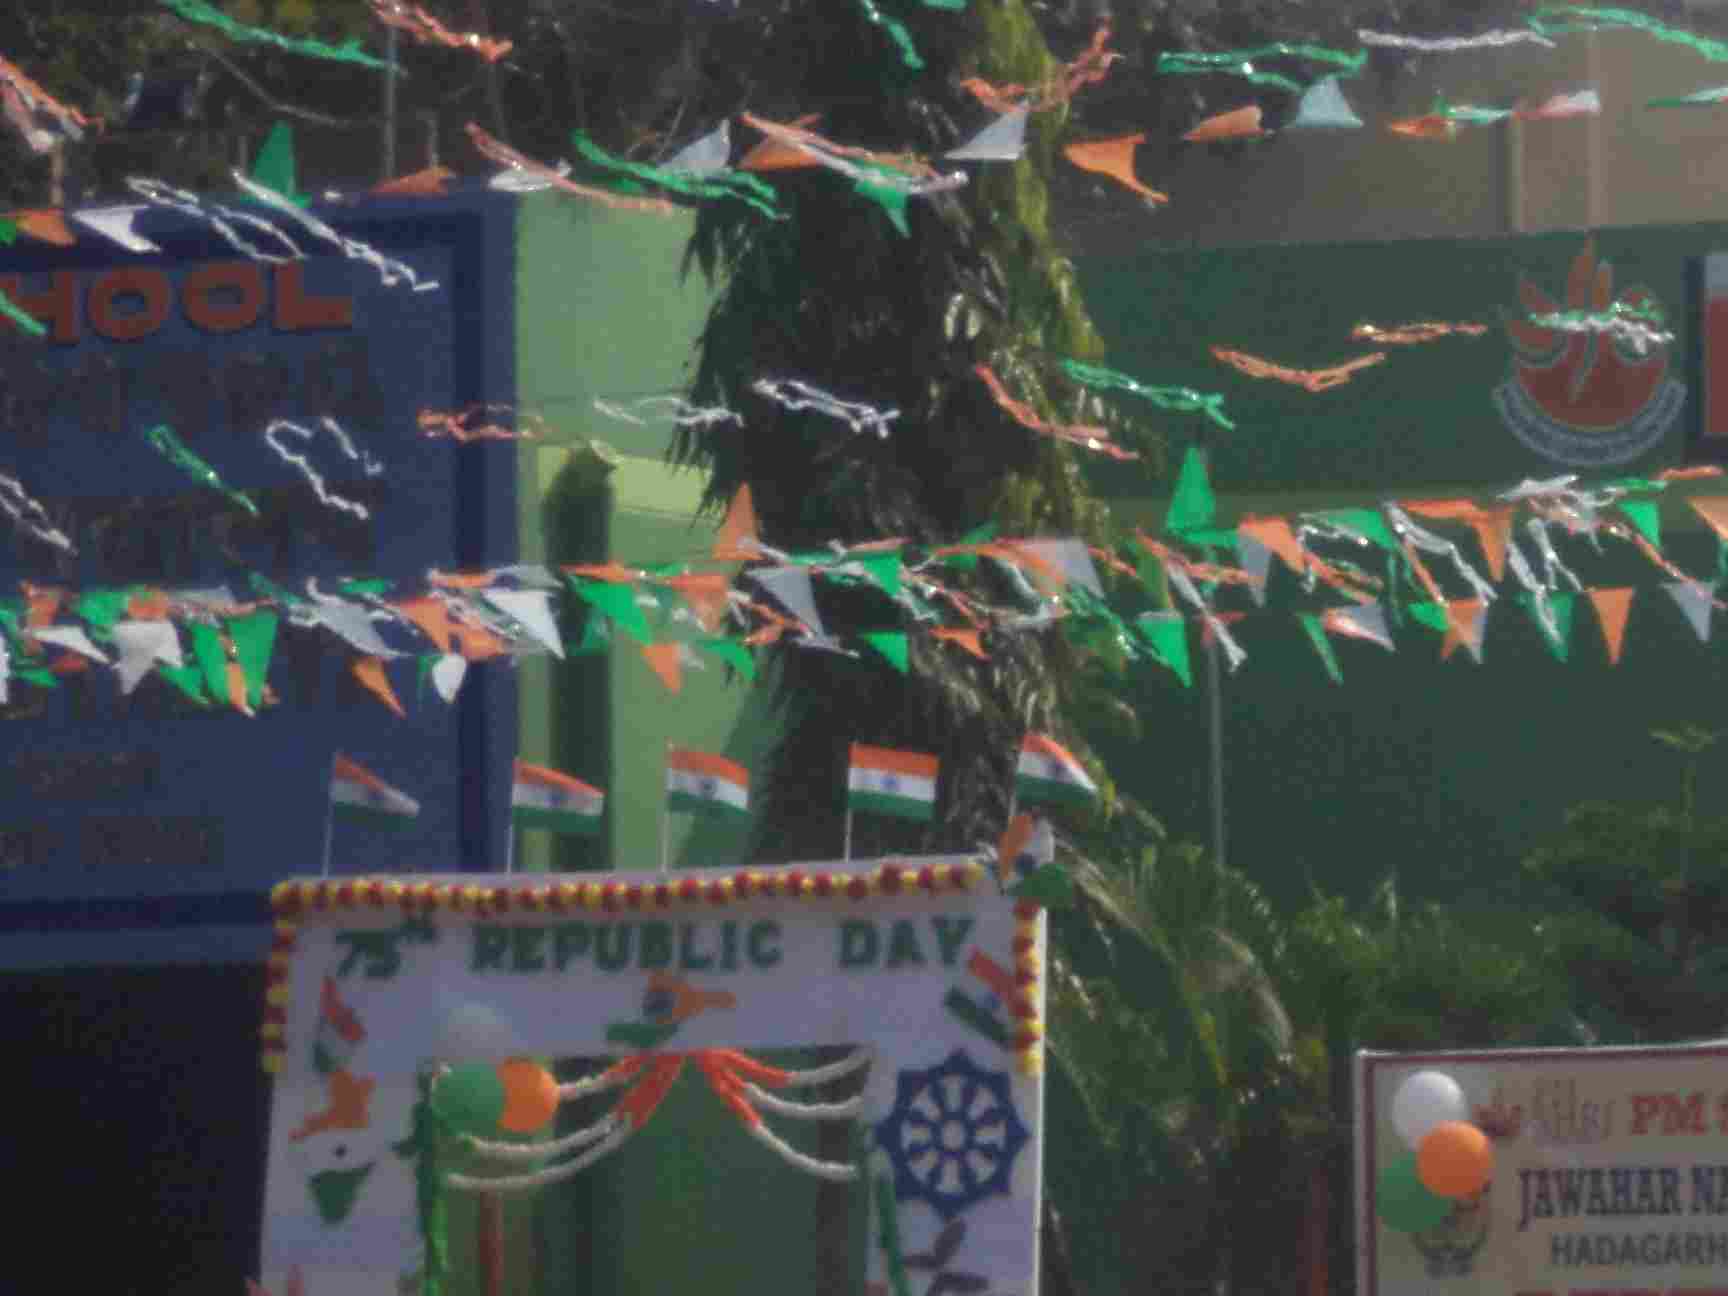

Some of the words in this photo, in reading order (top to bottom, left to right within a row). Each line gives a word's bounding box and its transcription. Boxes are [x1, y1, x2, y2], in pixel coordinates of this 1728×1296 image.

[471, 920, 783, 972] REPUBLIC
[838, 917, 973, 968] DAY
[1630, 1091, 1706, 1136] PM
[1517, 1166, 1684, 1230] JAWAHAR
